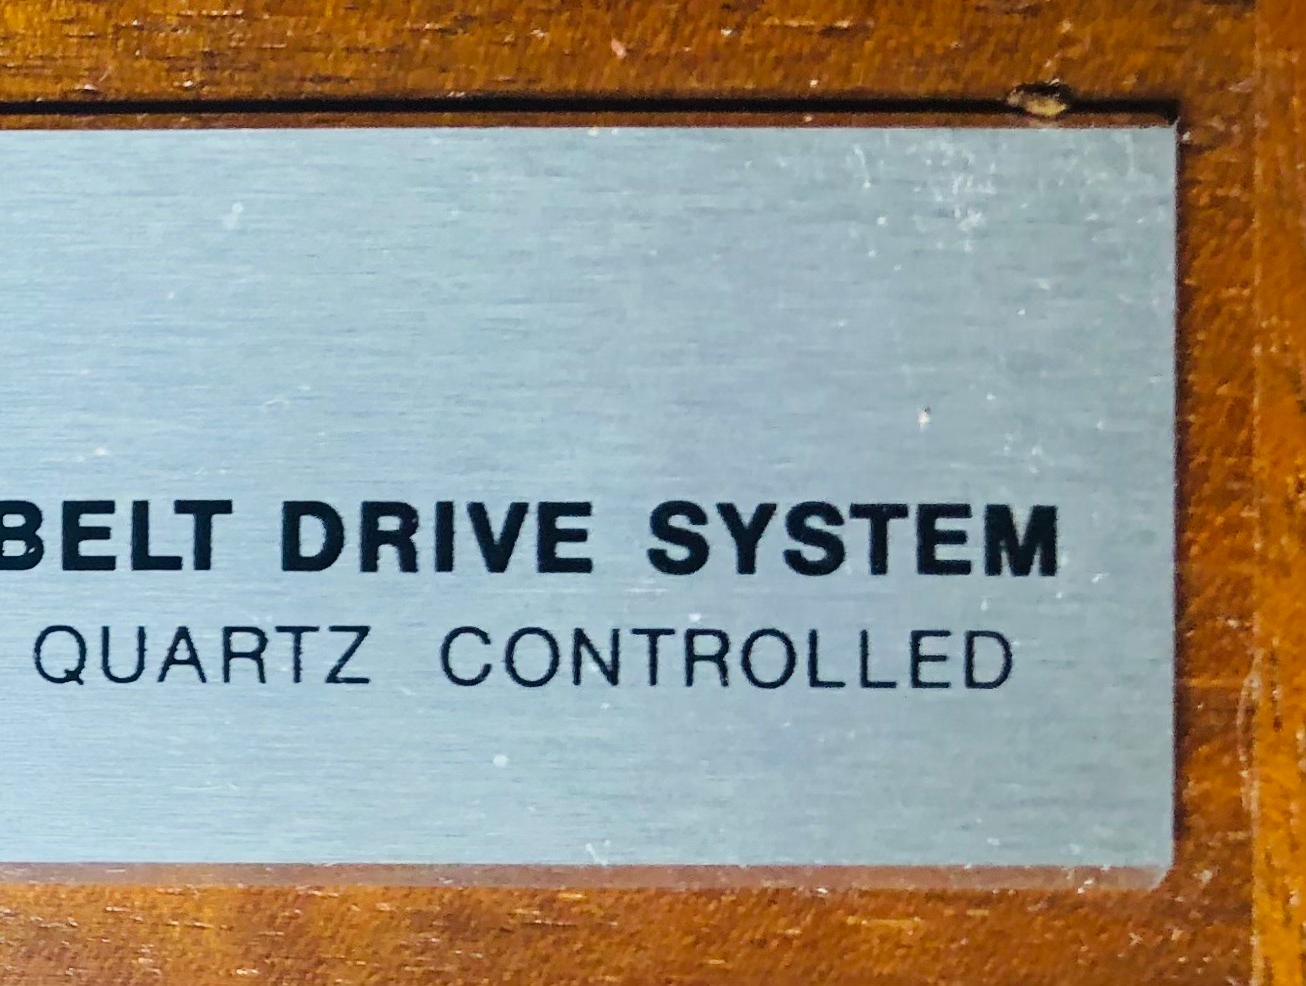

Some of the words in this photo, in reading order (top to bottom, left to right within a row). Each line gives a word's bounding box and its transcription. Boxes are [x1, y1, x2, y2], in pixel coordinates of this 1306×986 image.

[281, 500, 594, 574] DRIVE
[646, 500, 1060, 578] SYSTEM
[33, 624, 371, 686] QUARTZ
[440, 625, 1014, 690] CONTROLLED
